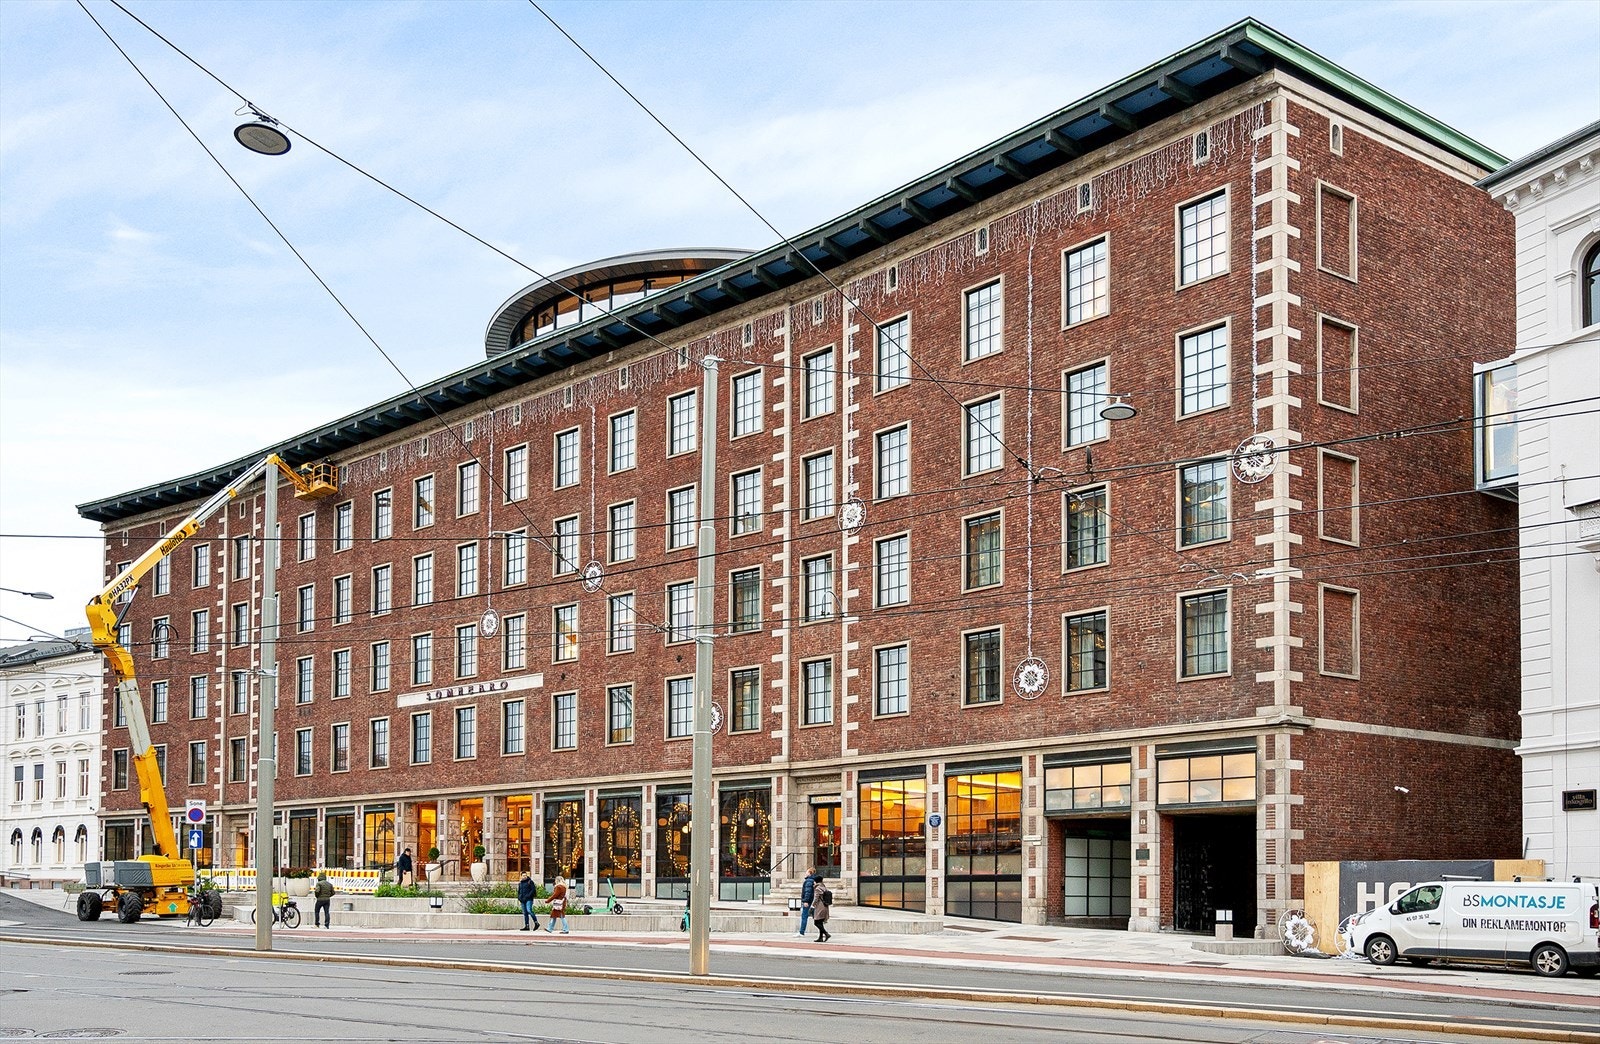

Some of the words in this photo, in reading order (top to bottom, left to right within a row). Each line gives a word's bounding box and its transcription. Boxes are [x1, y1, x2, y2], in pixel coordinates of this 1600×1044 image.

[160, 534, 183, 556] Haulotte
[111, 574, 135, 597] HA32PX
[1463, 894, 1566, 909] BSMONTASJE
[1462, 918, 1477, 929] DIN
[1480, 918, 1567, 933] REKLAMEMONTØR
